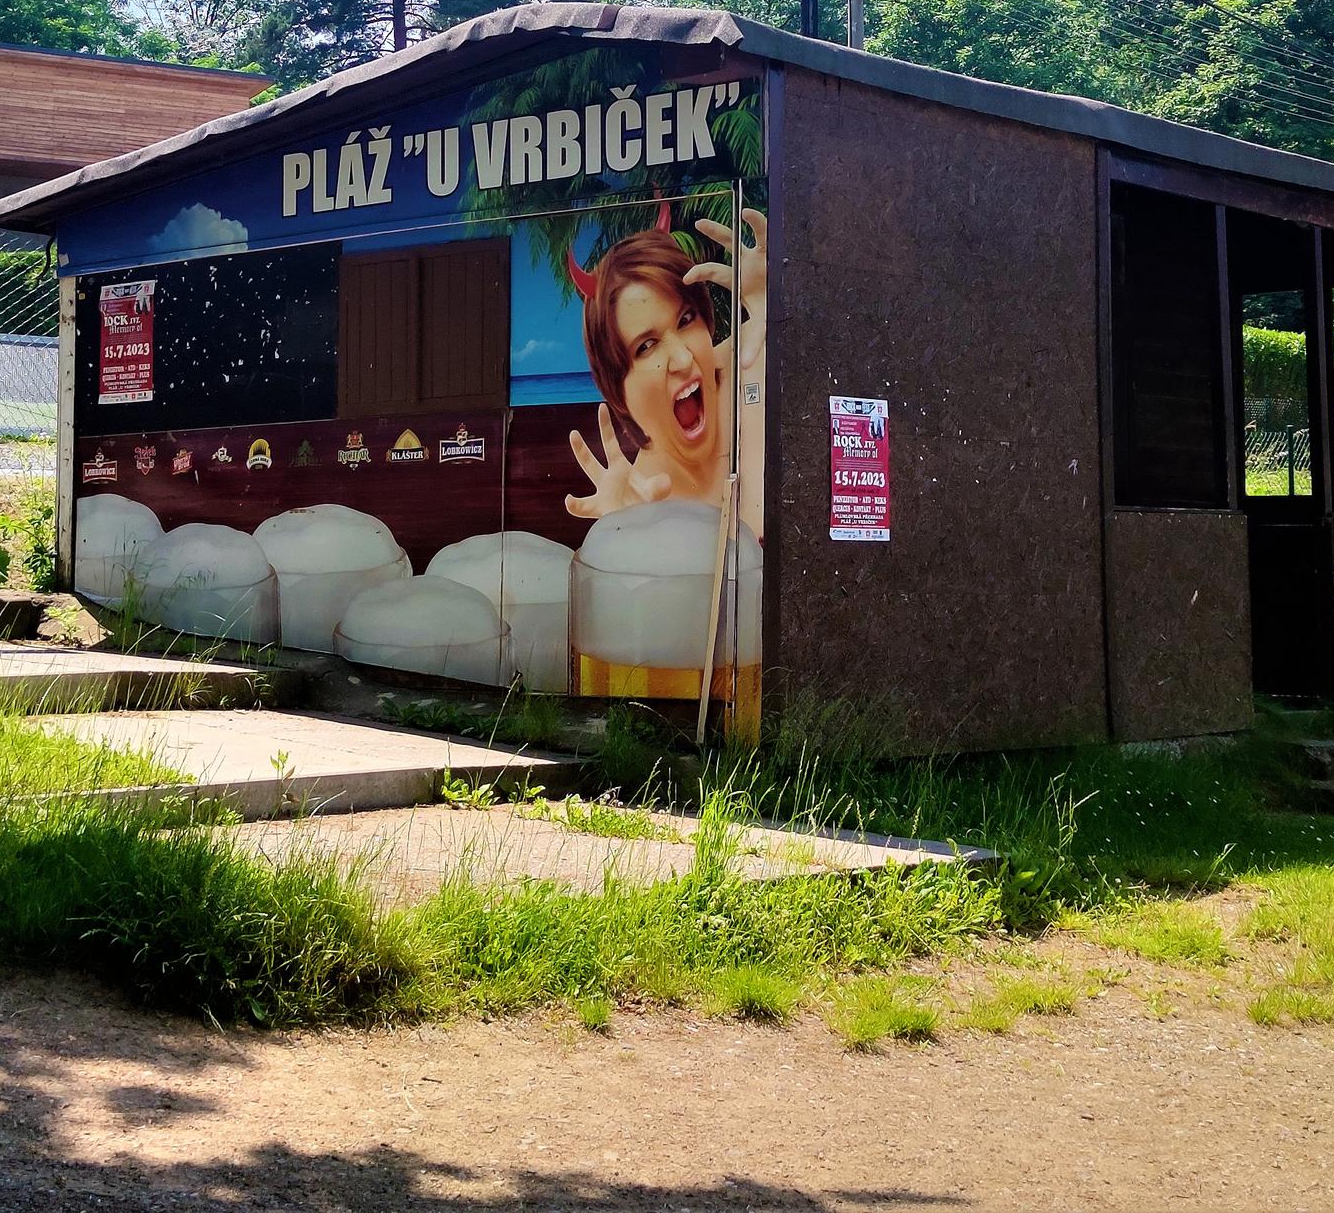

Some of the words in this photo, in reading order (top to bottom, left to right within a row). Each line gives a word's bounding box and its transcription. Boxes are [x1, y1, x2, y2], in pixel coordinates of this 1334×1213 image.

[282, 125, 392, 217] PLÁŽ
[105, 343, 150, 359] 15.7.2023
[833, 435, 863, 449] ROCK
[391, 450, 424, 461] KLÁŠTER
[834, 470, 886, 488] 15.7.2023
